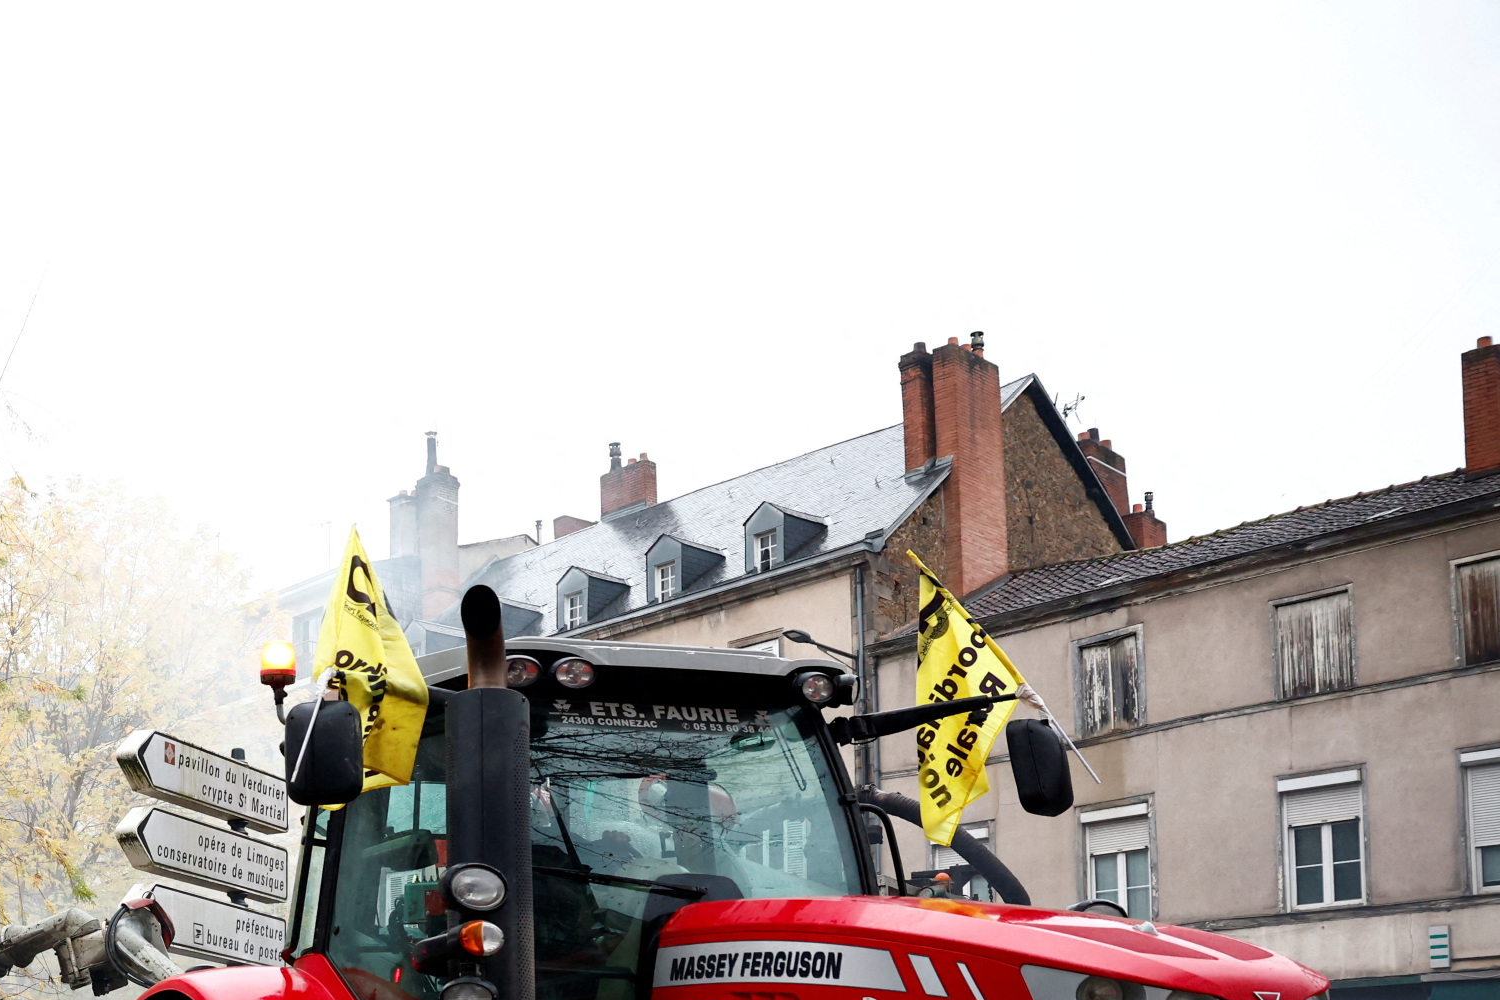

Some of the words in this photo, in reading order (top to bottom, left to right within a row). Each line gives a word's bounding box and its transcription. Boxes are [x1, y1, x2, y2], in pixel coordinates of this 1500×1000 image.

[561, 715, 595, 725] 24300
[597, 717, 658, 729] CONNEZAC
[589, 701, 646, 719] ETS.
[652, 704, 740, 724] FAURIE
[693, 722, 707, 731] 05
[710, 723, 723, 732] 53
[726, 724, 739, 733] 60
[742, 725, 755, 734] 38
[178, 753, 220, 779] pavillon
[225, 767, 237, 784] du
[242, 772, 285, 801] Verdurier
[202, 783, 233, 804] crypte
[238, 793, 248, 808] St
[251, 797, 286, 822] Martial
[157, 844, 227, 875] conservatoire
[232, 863, 243, 879] de
[247, 869, 285, 892] musique
[198, 835, 226, 853] opéra
[231, 842, 242, 858] de
[247, 846, 285, 872] Limoges
[236, 918, 283, 941] préfecture
[206, 929, 239, 952] bureau
[244, 939, 254, 955] de
[258, 946, 282, 962] poste
[669, 952, 739, 981] MASSEY
[740, 951, 843, 980] FERGUSON
